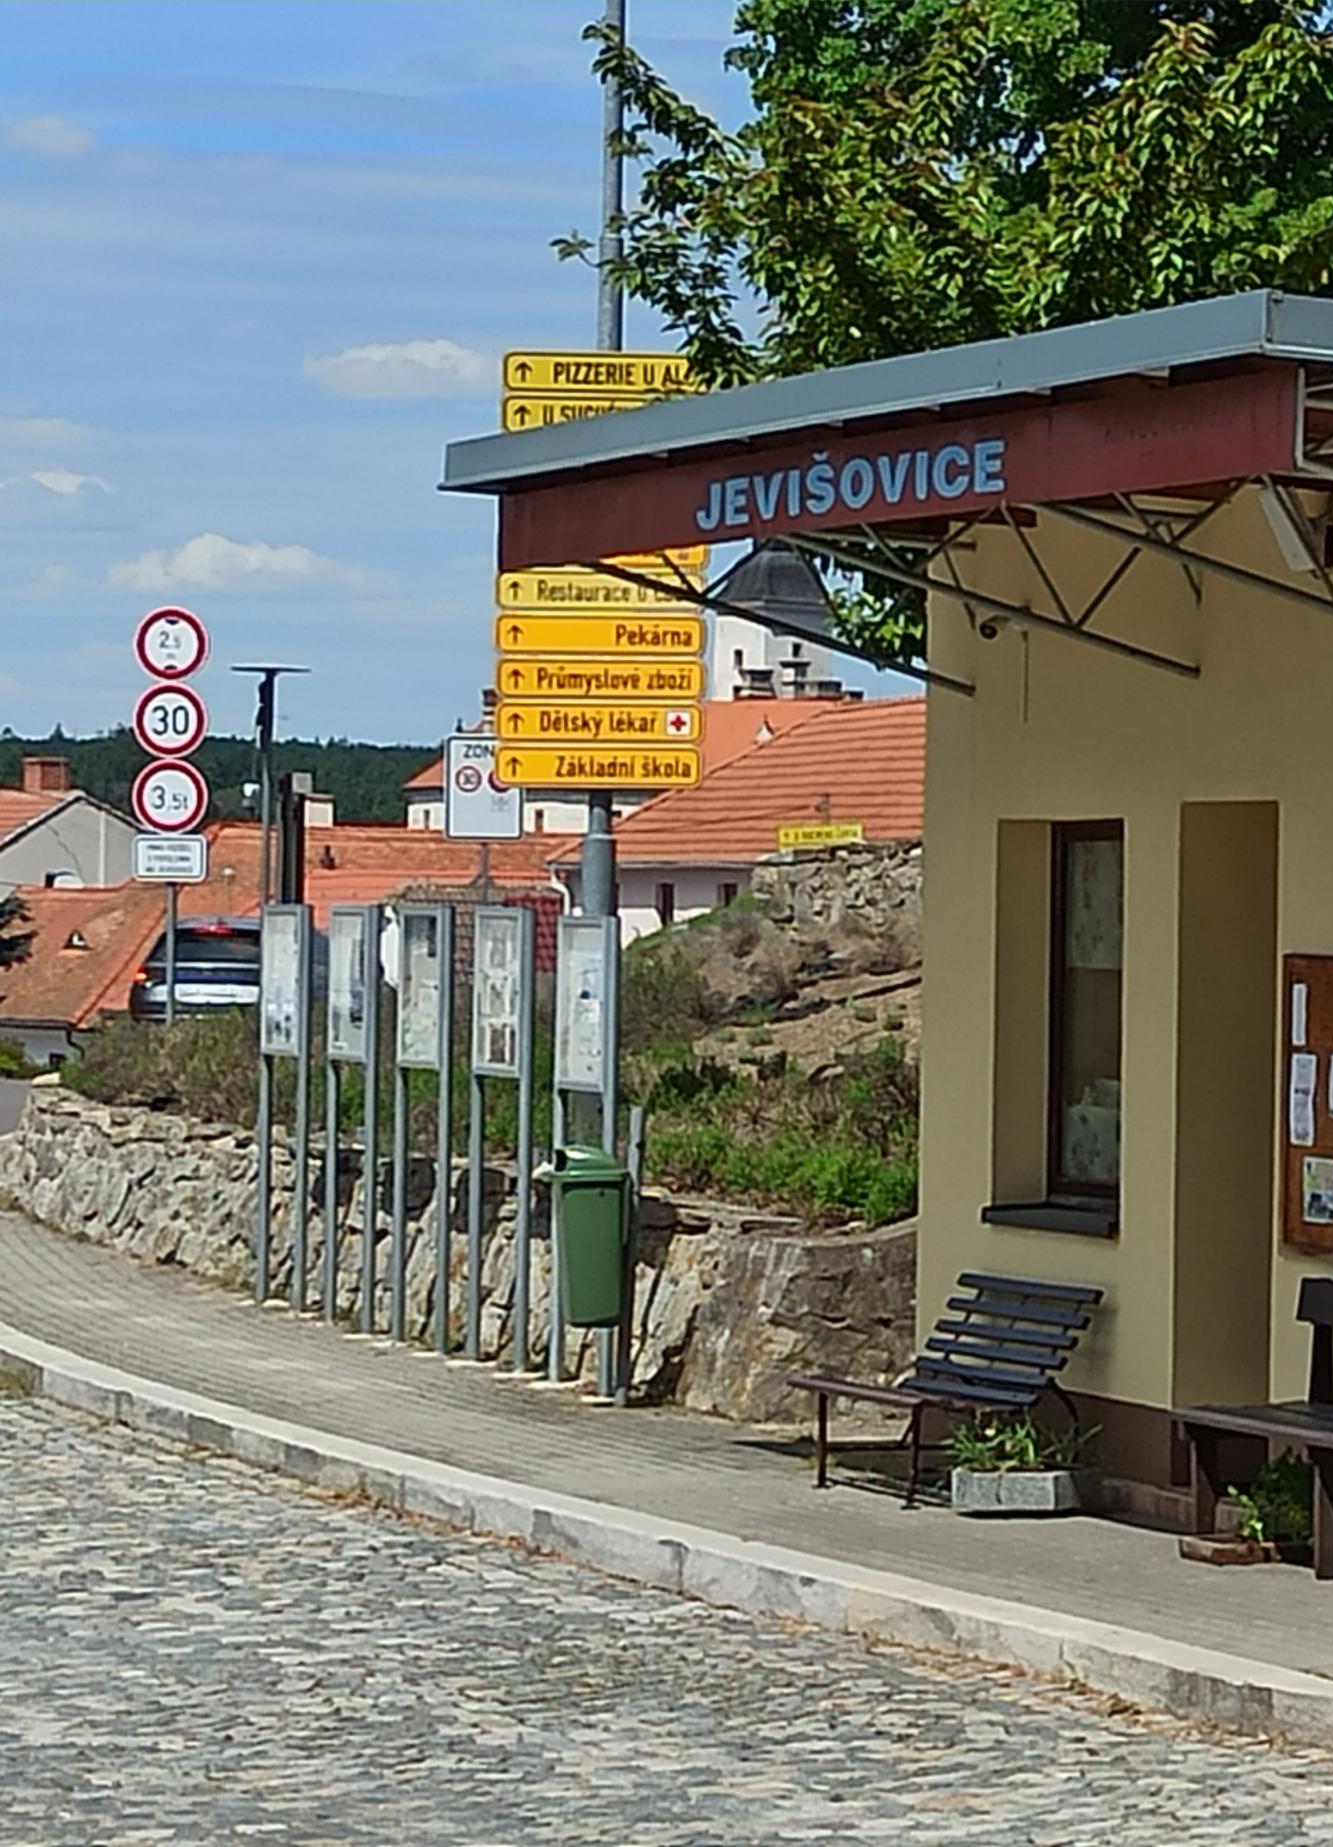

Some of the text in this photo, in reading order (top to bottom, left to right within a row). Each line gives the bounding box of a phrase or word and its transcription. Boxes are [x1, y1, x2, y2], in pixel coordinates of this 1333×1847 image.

[553, 362, 693, 387] PIZZERIE U AL
[543, 404, 554, 426] U
[696, 440, 1006, 530] JEVIŠOVICE
[536, 579, 632, 603] Restaurace
[614, 624, 693, 647] Pekárna
[536, 667, 693, 695] Průmyslové zboží
[152, 705, 190, 736] 30
[539, 709, 657, 739] Dětský lékař
[463, 744, 497, 759] ZON
[555, 756, 692, 779] Základní škola
